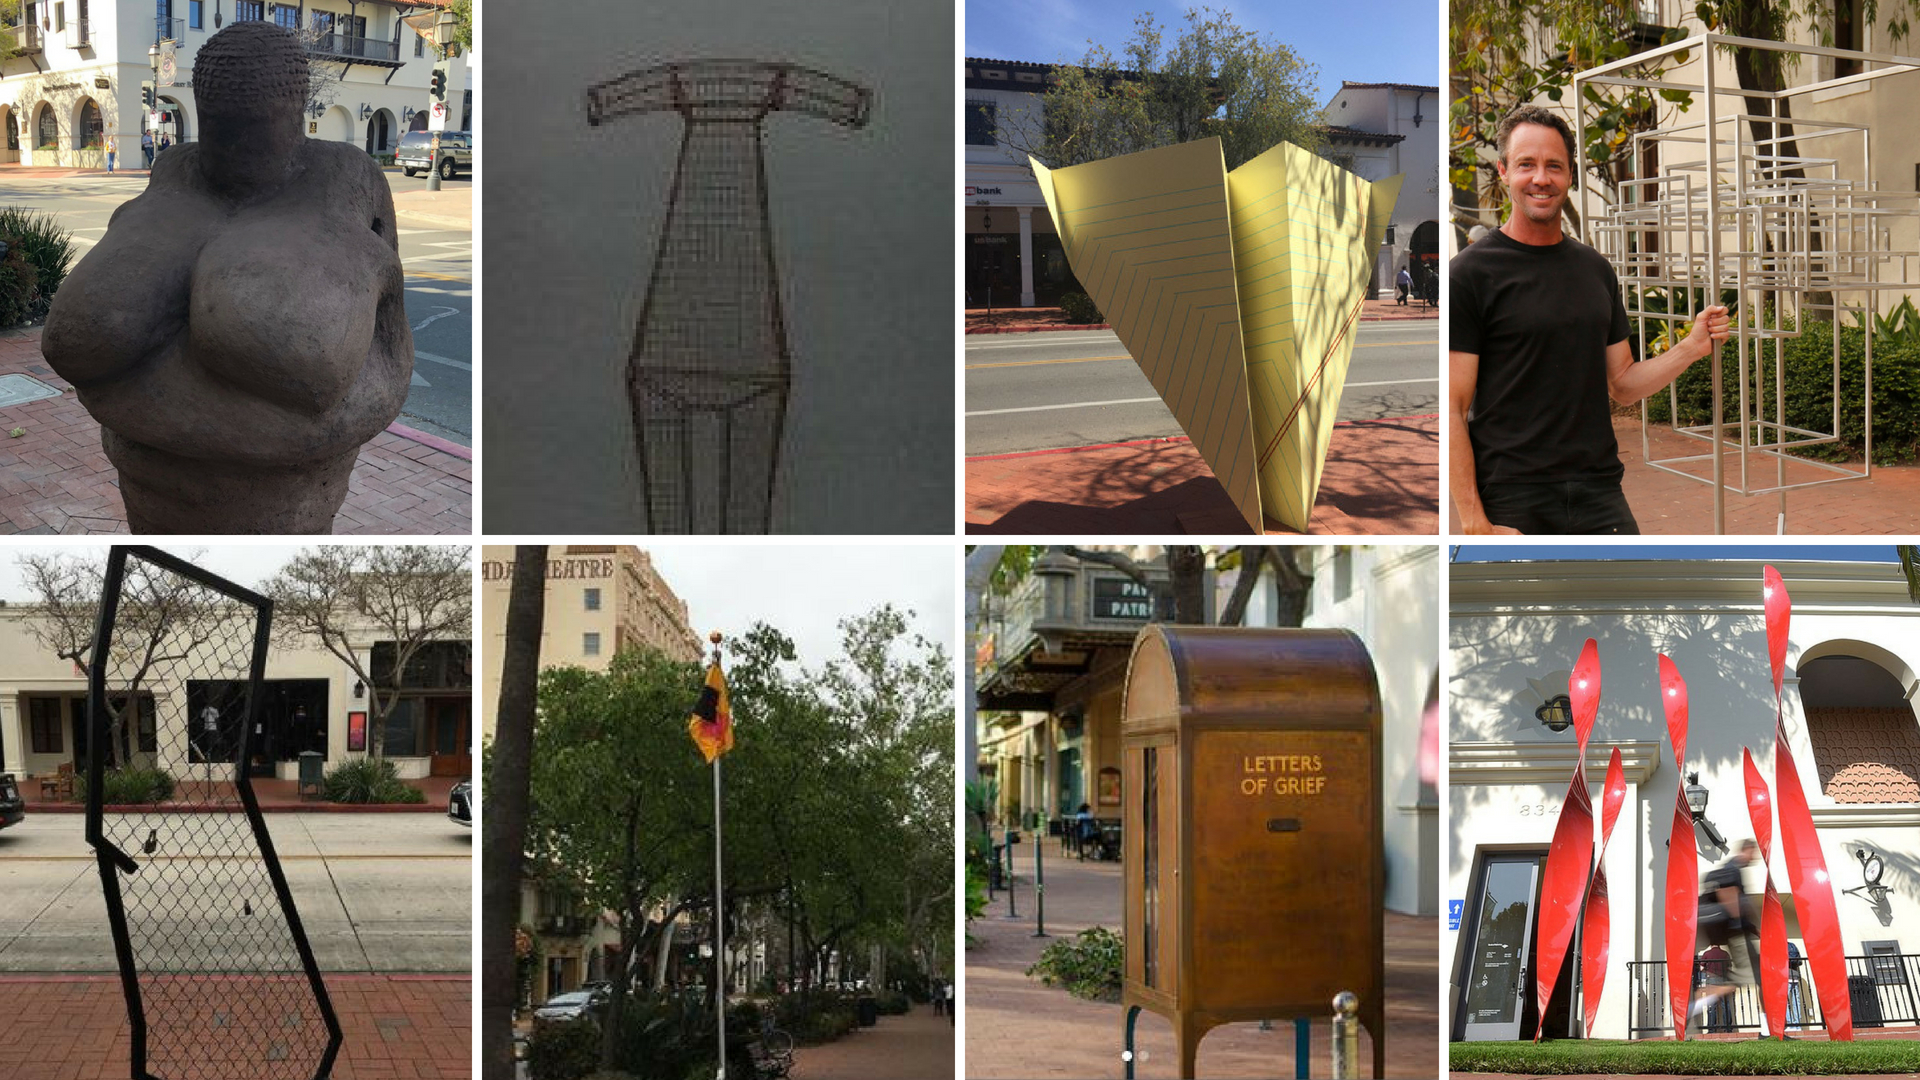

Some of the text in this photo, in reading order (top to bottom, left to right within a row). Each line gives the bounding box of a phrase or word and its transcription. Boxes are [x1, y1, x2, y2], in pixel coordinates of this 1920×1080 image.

[976, 186, 1002, 195] bank
[1111, 601, 1154, 616] PATR
[1244, 755, 1322, 772] LETTERS
[1241, 776, 1326, 795] OF GRIEF
[1519, 804, 1560, 816] 834
